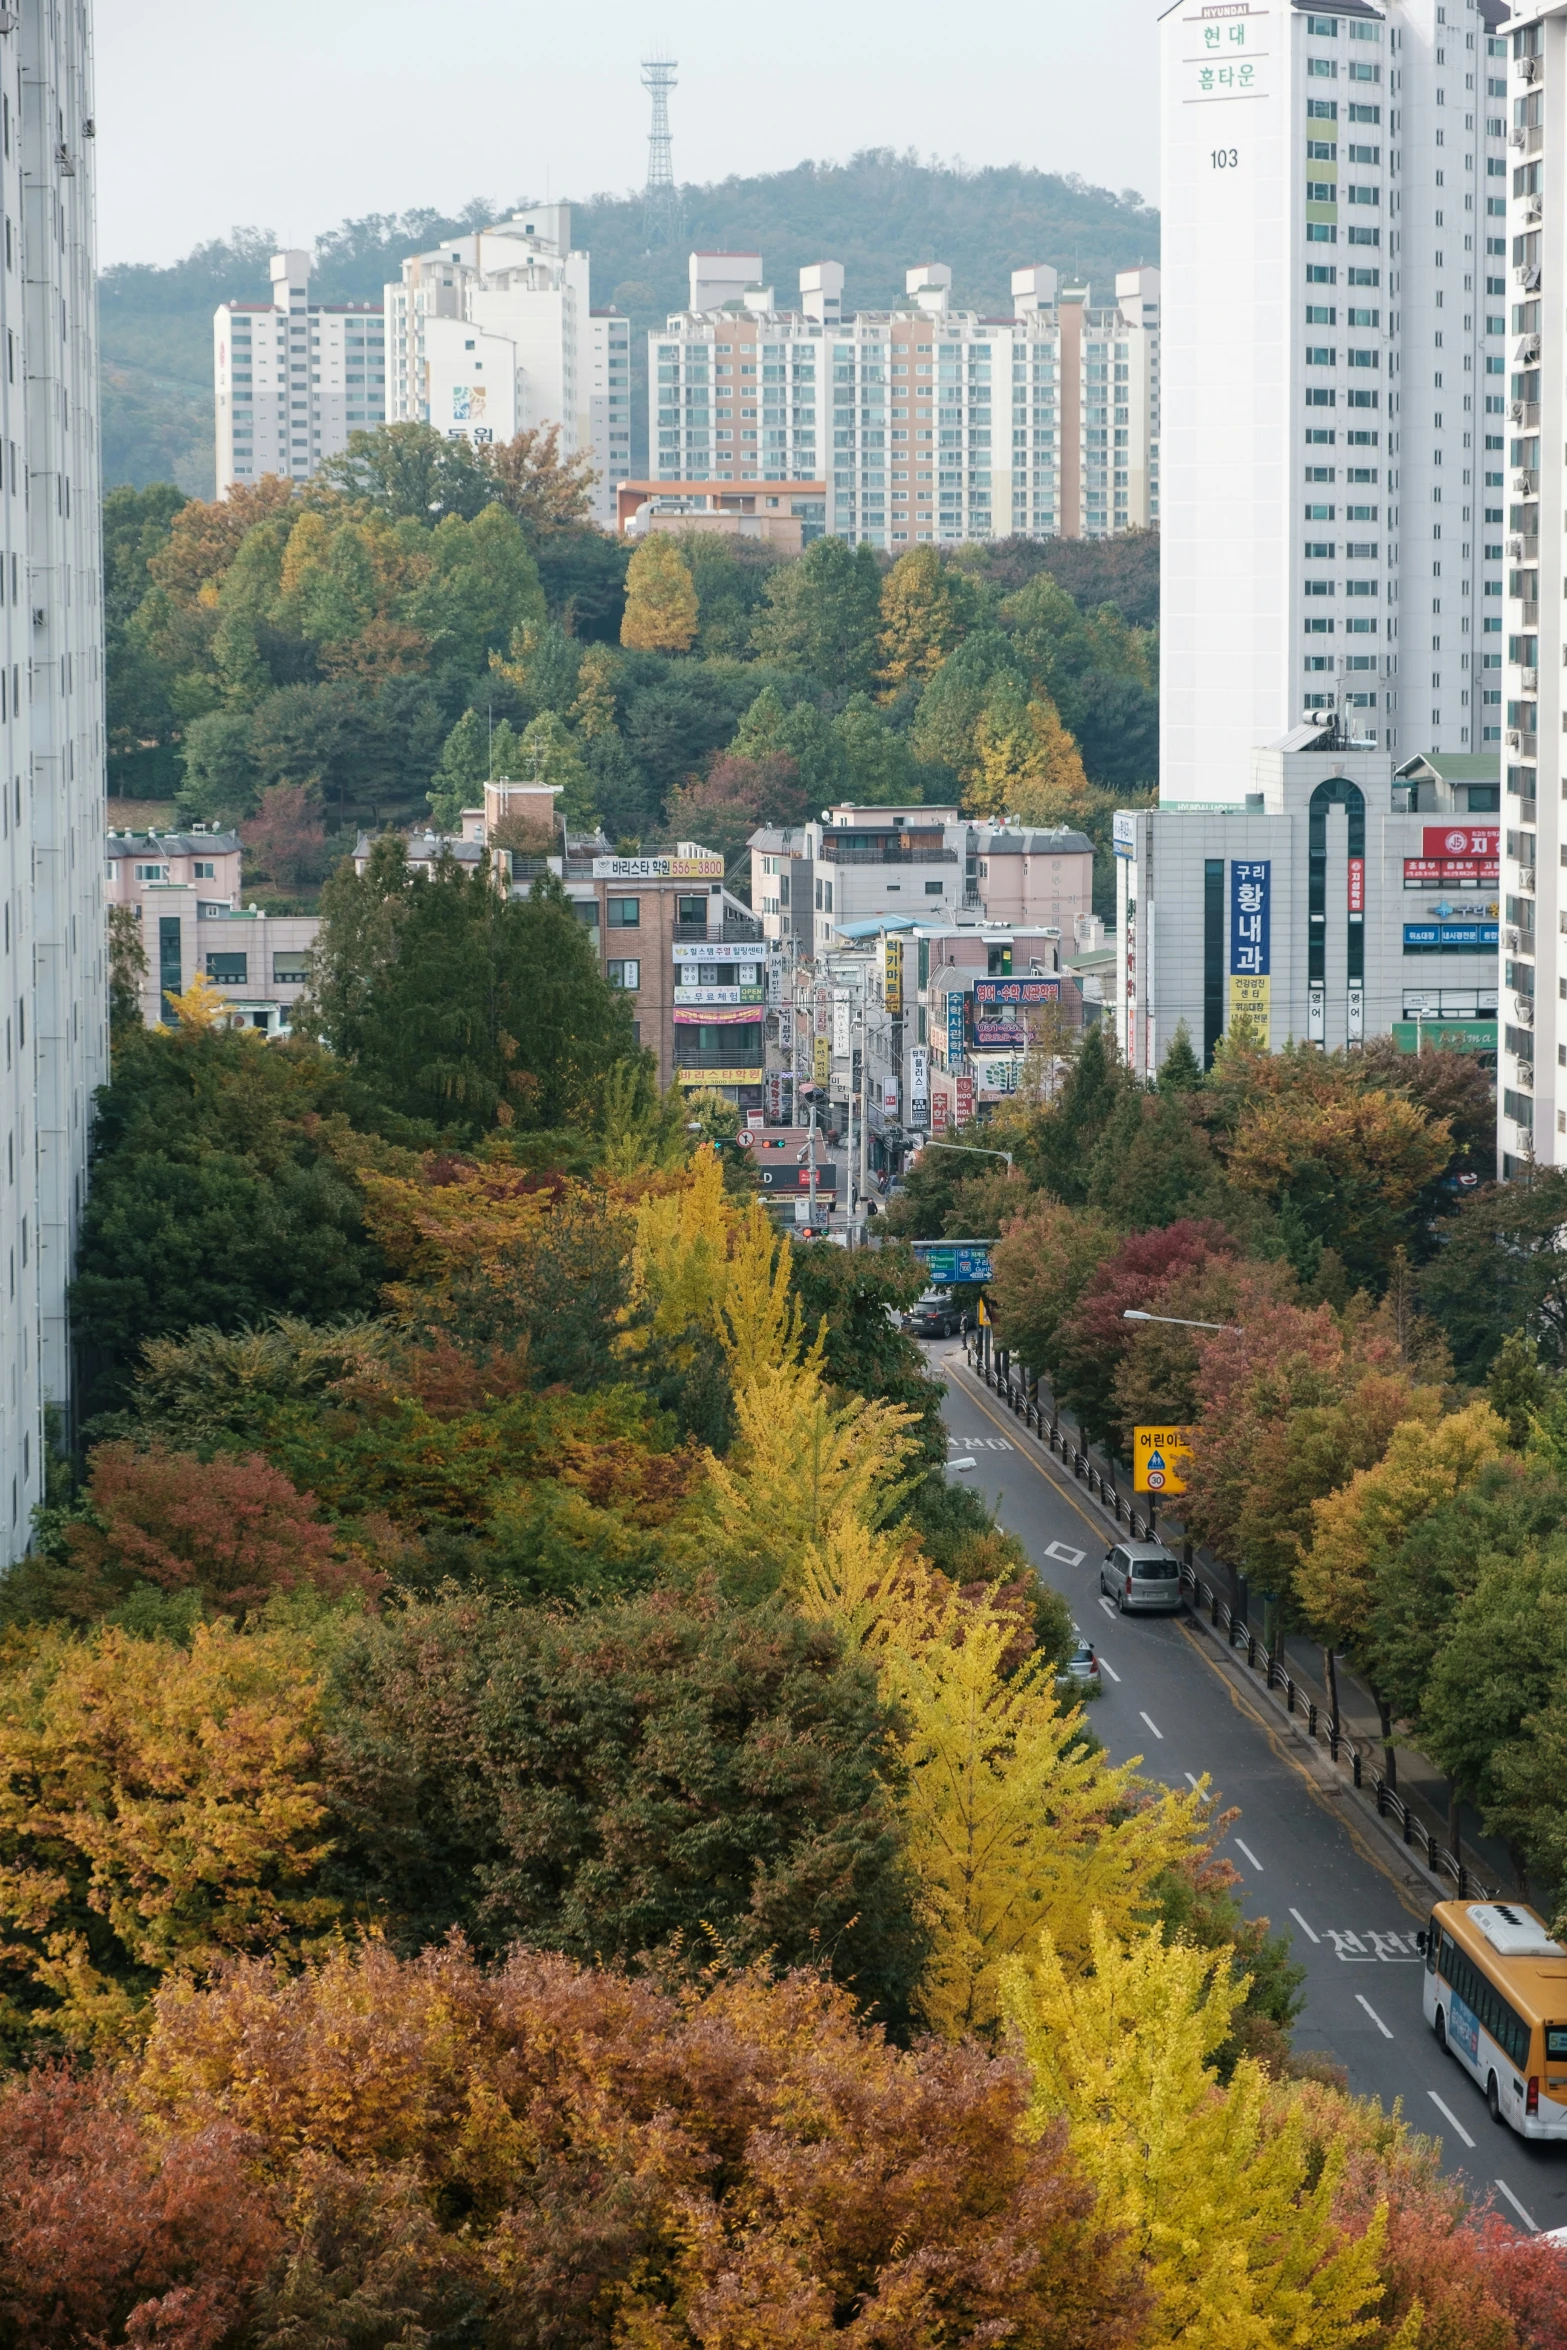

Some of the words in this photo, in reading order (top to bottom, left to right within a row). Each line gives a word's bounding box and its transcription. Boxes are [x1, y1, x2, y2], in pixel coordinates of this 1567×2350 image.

[1204, 5, 1247, 18] HYUNDAI
[1198, 64, 1255, 90] 홈타운
[1211, 148, 1238, 169] 103
[612, 860, 649, 875] 바리스타
[653, 860, 670, 875] 학원
[672, 861, 722, 874] 556-3800
[1237, 865, 1265, 880] 구리
[1351, 873, 1361, 908] 지성학원
[1237, 883, 1264, 974] 황내과
[1409, 932, 1435, 940] 위&대장
[770, 959, 781, 967] JM
[887, 941, 898, 993] 럭키마트
[1235, 979, 1265, 988] 건강검진
[1022, 984, 1059, 1001] 사관학원
[1312, 994, 1320, 1017] 영어
[1351, 994, 1360, 1017] 영어
[949, 993, 962, 1063] 수학사관학원
[912, 1050, 926, 1058] 뮤직
[680, 1070, 760, 1080] 바리스타학원
[915, 1059, 923, 1086] 플러스
[934, 1095, 946, 1122] 수학
[960, 1250, 969, 1258] 43
[1151, 1476, 1162, 1485] 30
